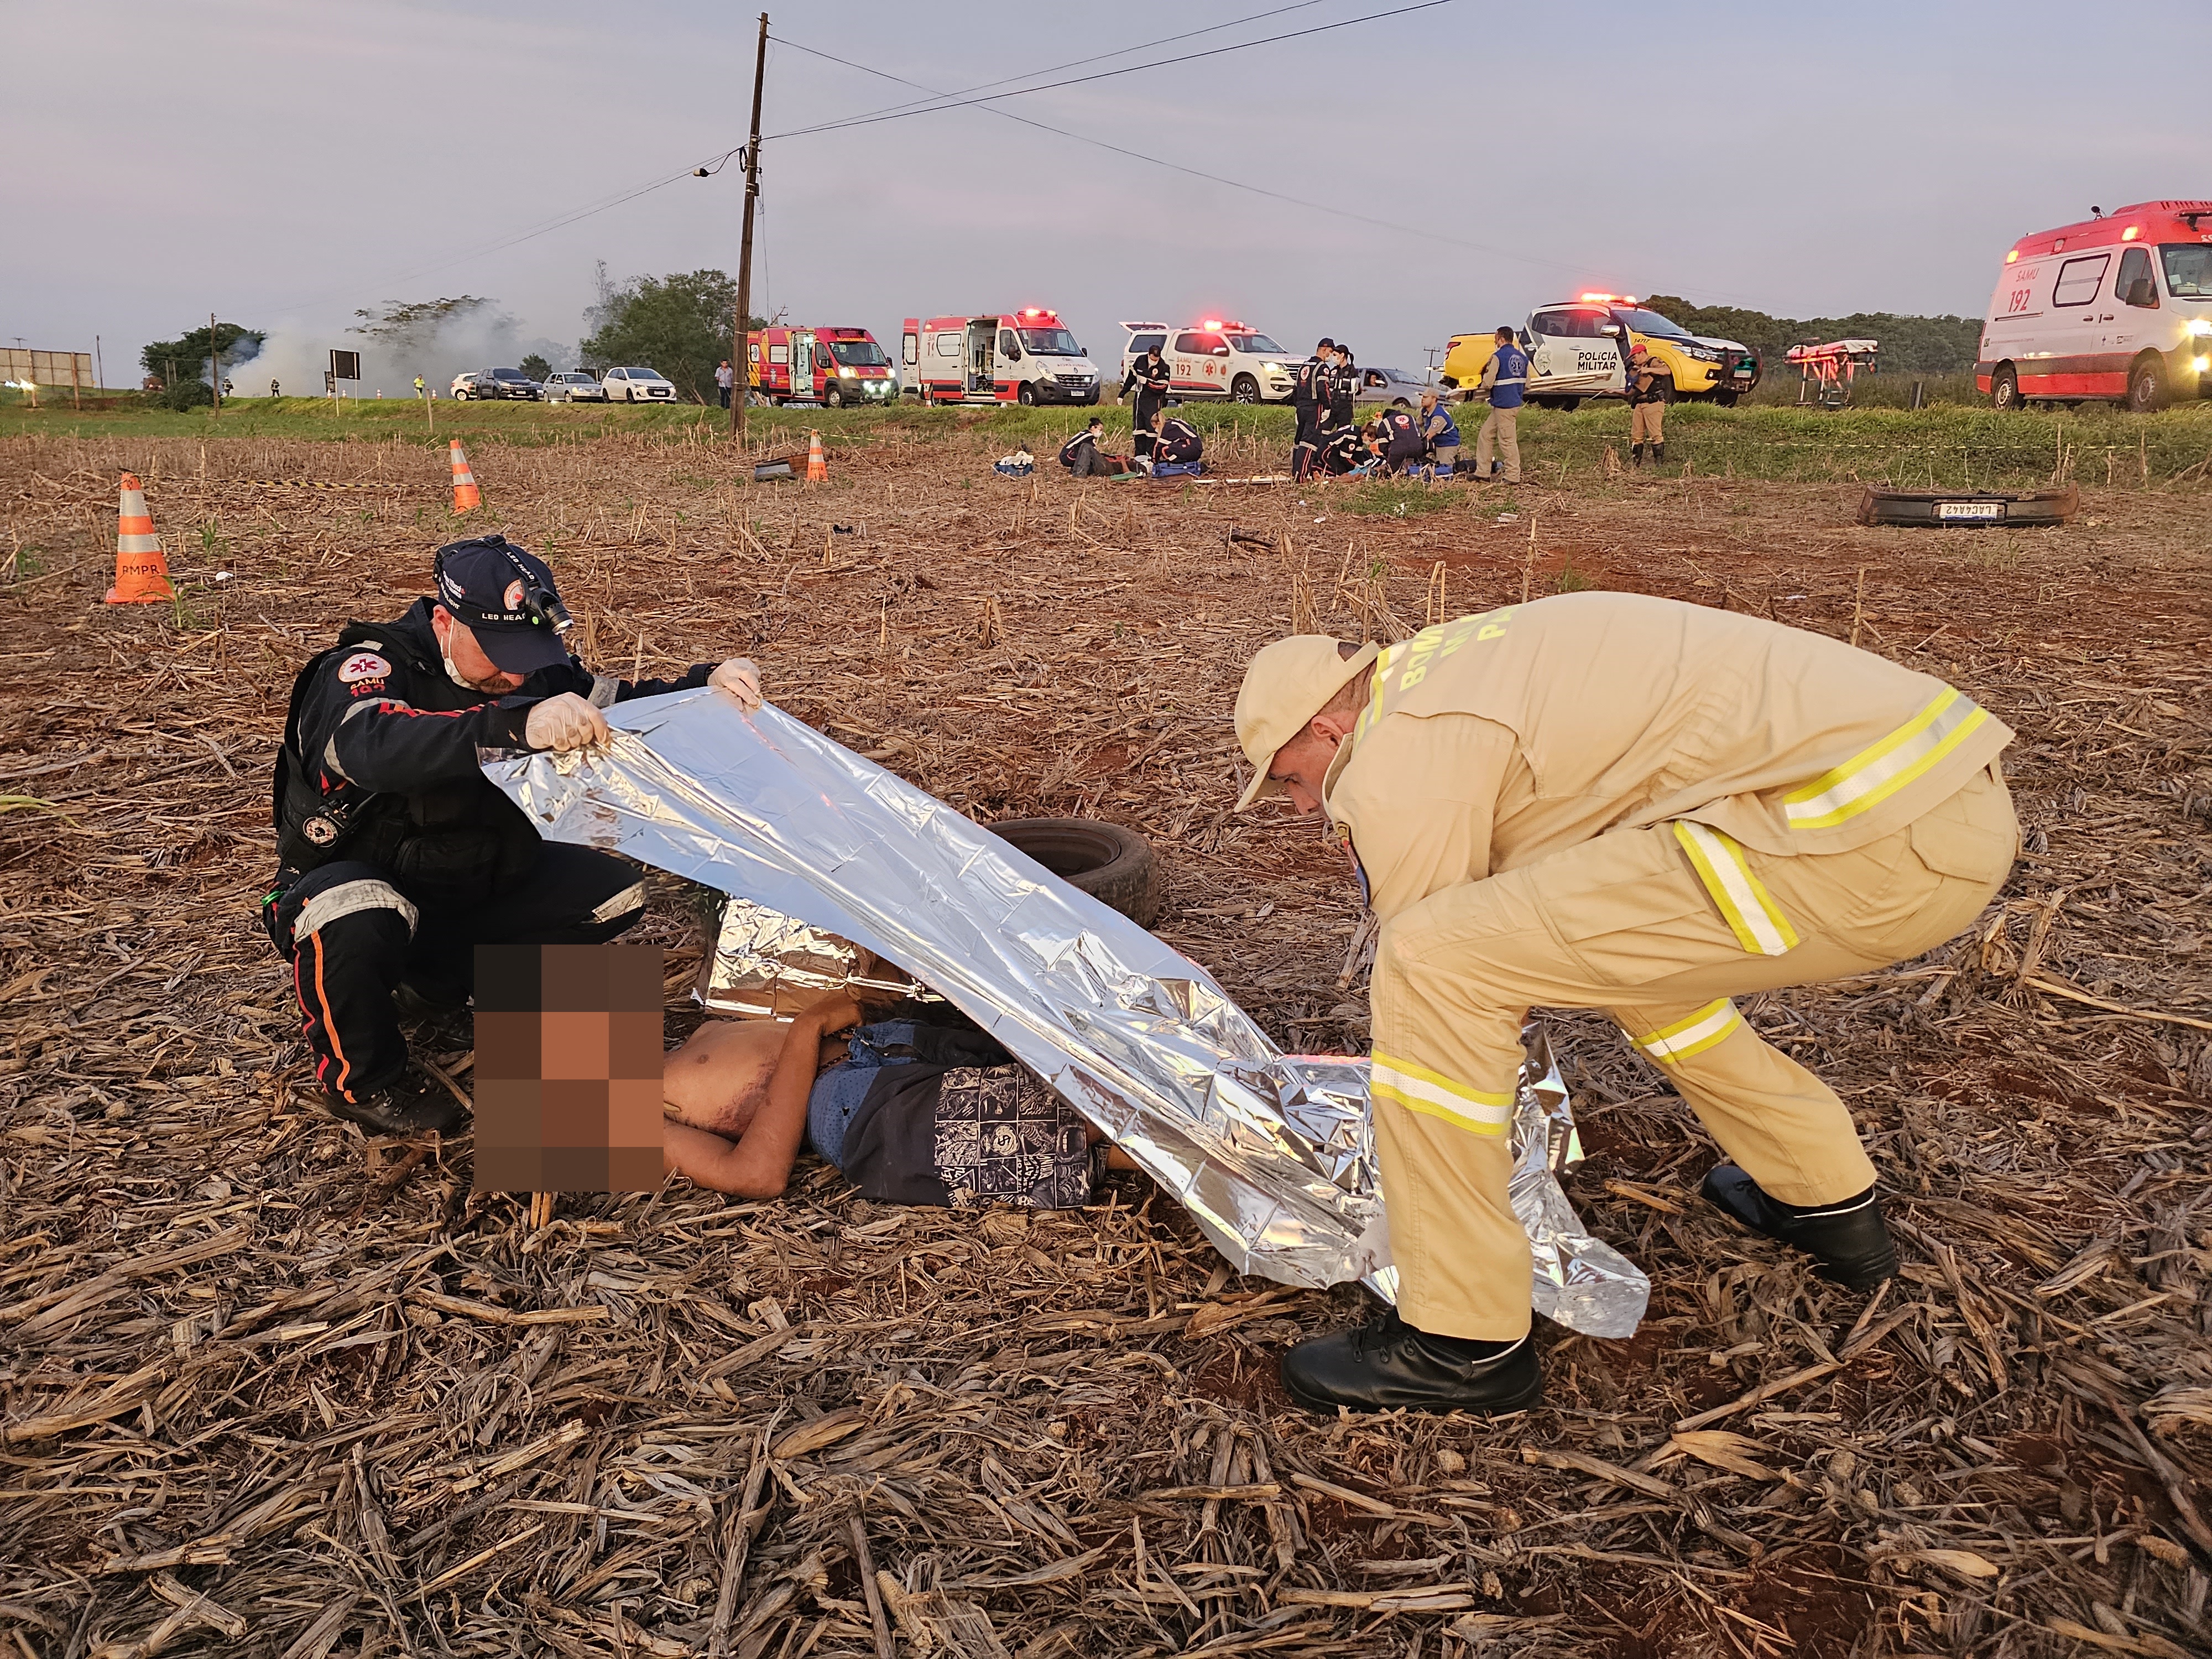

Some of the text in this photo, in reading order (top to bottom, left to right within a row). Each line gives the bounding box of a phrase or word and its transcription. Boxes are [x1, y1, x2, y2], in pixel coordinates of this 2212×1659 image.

[2015, 268, 2040, 283] SAMU
[2008, 288, 2031, 312] 192
[1578, 351, 1618, 361] POLÍCIA
[1176, 364, 1191, 376] 192
[1577, 361, 1616, 371] MILITAR
[1946, 505, 1991, 514] LAC4A42
[122, 565, 160, 575] PMPR
[507, 552, 519, 564] LED
[518, 564, 535, 580] HEAD
[1477, 607, 1519, 641] PA
